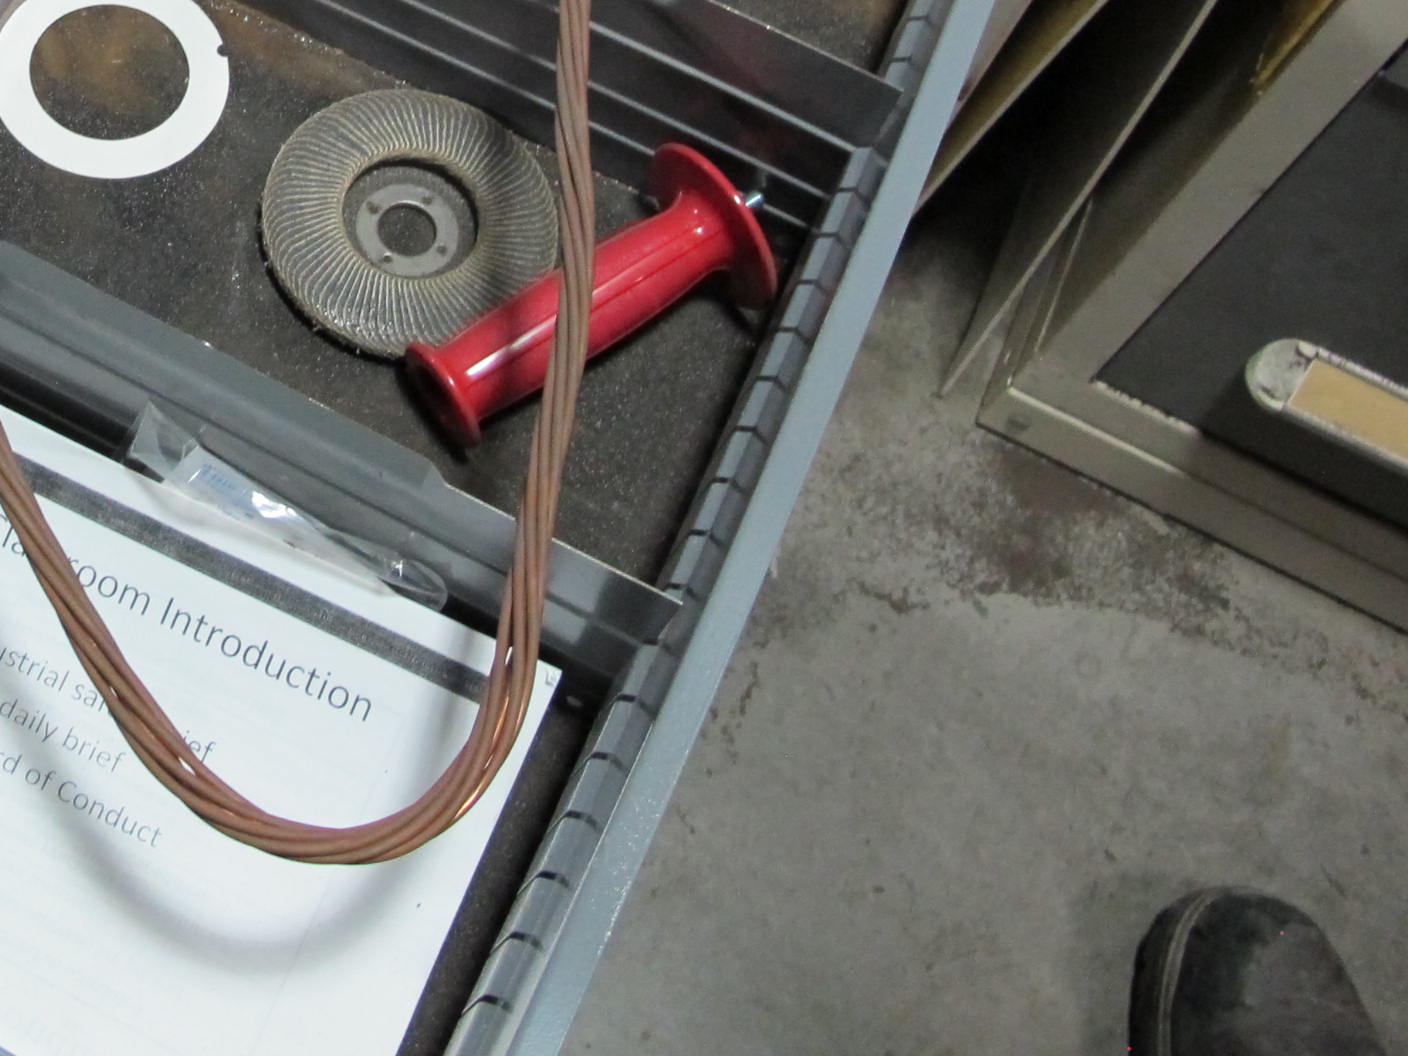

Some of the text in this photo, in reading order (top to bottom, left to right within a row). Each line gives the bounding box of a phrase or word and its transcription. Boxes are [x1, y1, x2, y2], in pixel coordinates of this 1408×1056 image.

[160, 597, 373, 722] Introduction
[0, 699, 58, 743] daily
[63, 727, 126, 772] brief
[25, 768, 56, 791] of
[58, 780, 163, 847] Conduct
